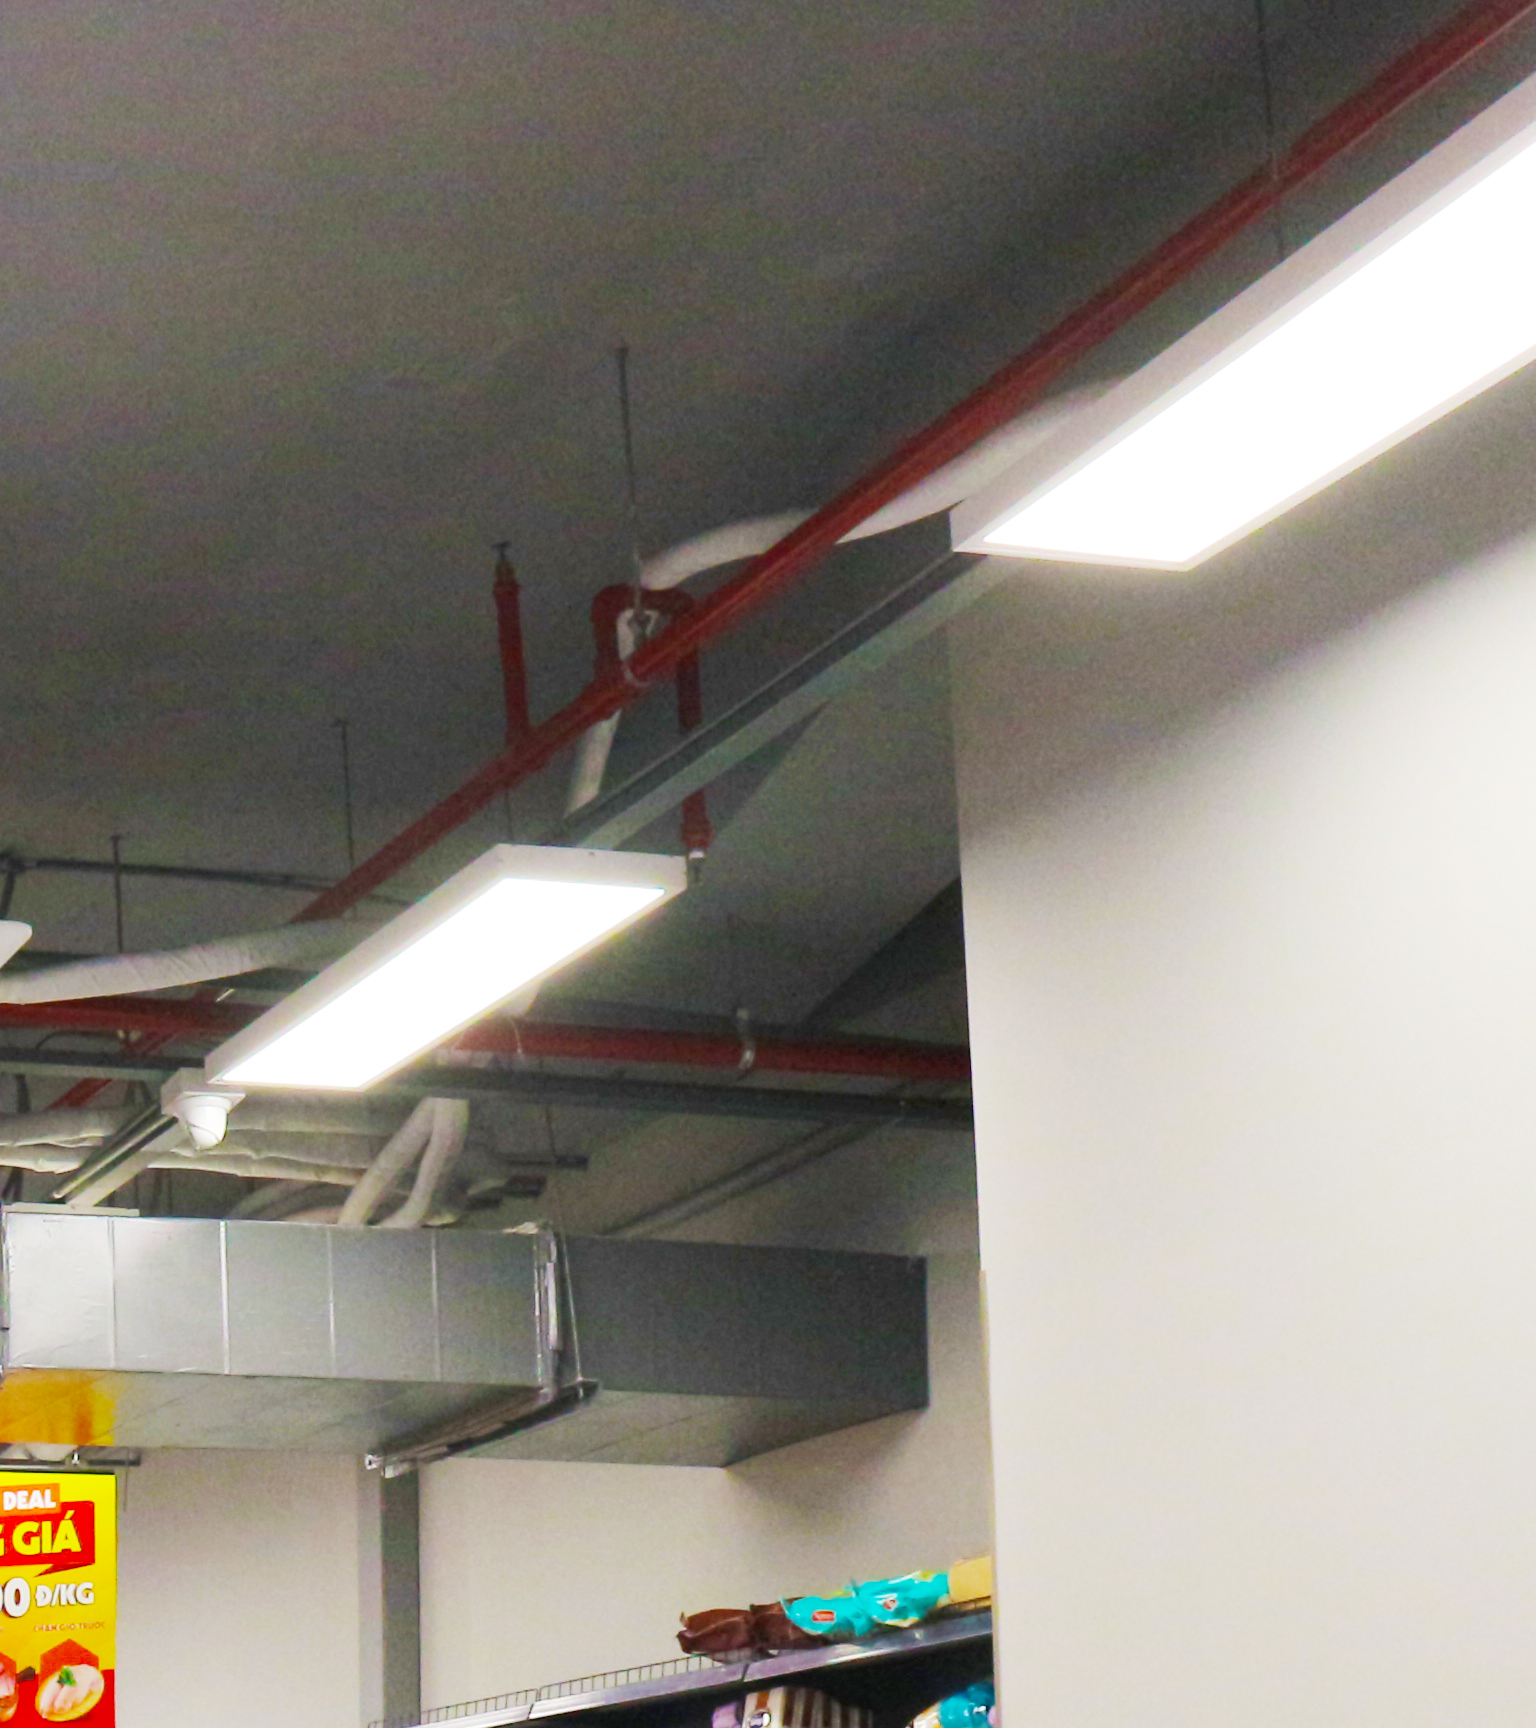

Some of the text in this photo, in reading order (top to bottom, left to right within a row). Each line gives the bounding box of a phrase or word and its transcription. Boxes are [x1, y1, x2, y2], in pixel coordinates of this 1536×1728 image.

[3, 1489, 56, 1511] DEAL
[12, 1510, 82, 1555] GIÁ
[35, 1582, 95, 1608] Đ/KG
